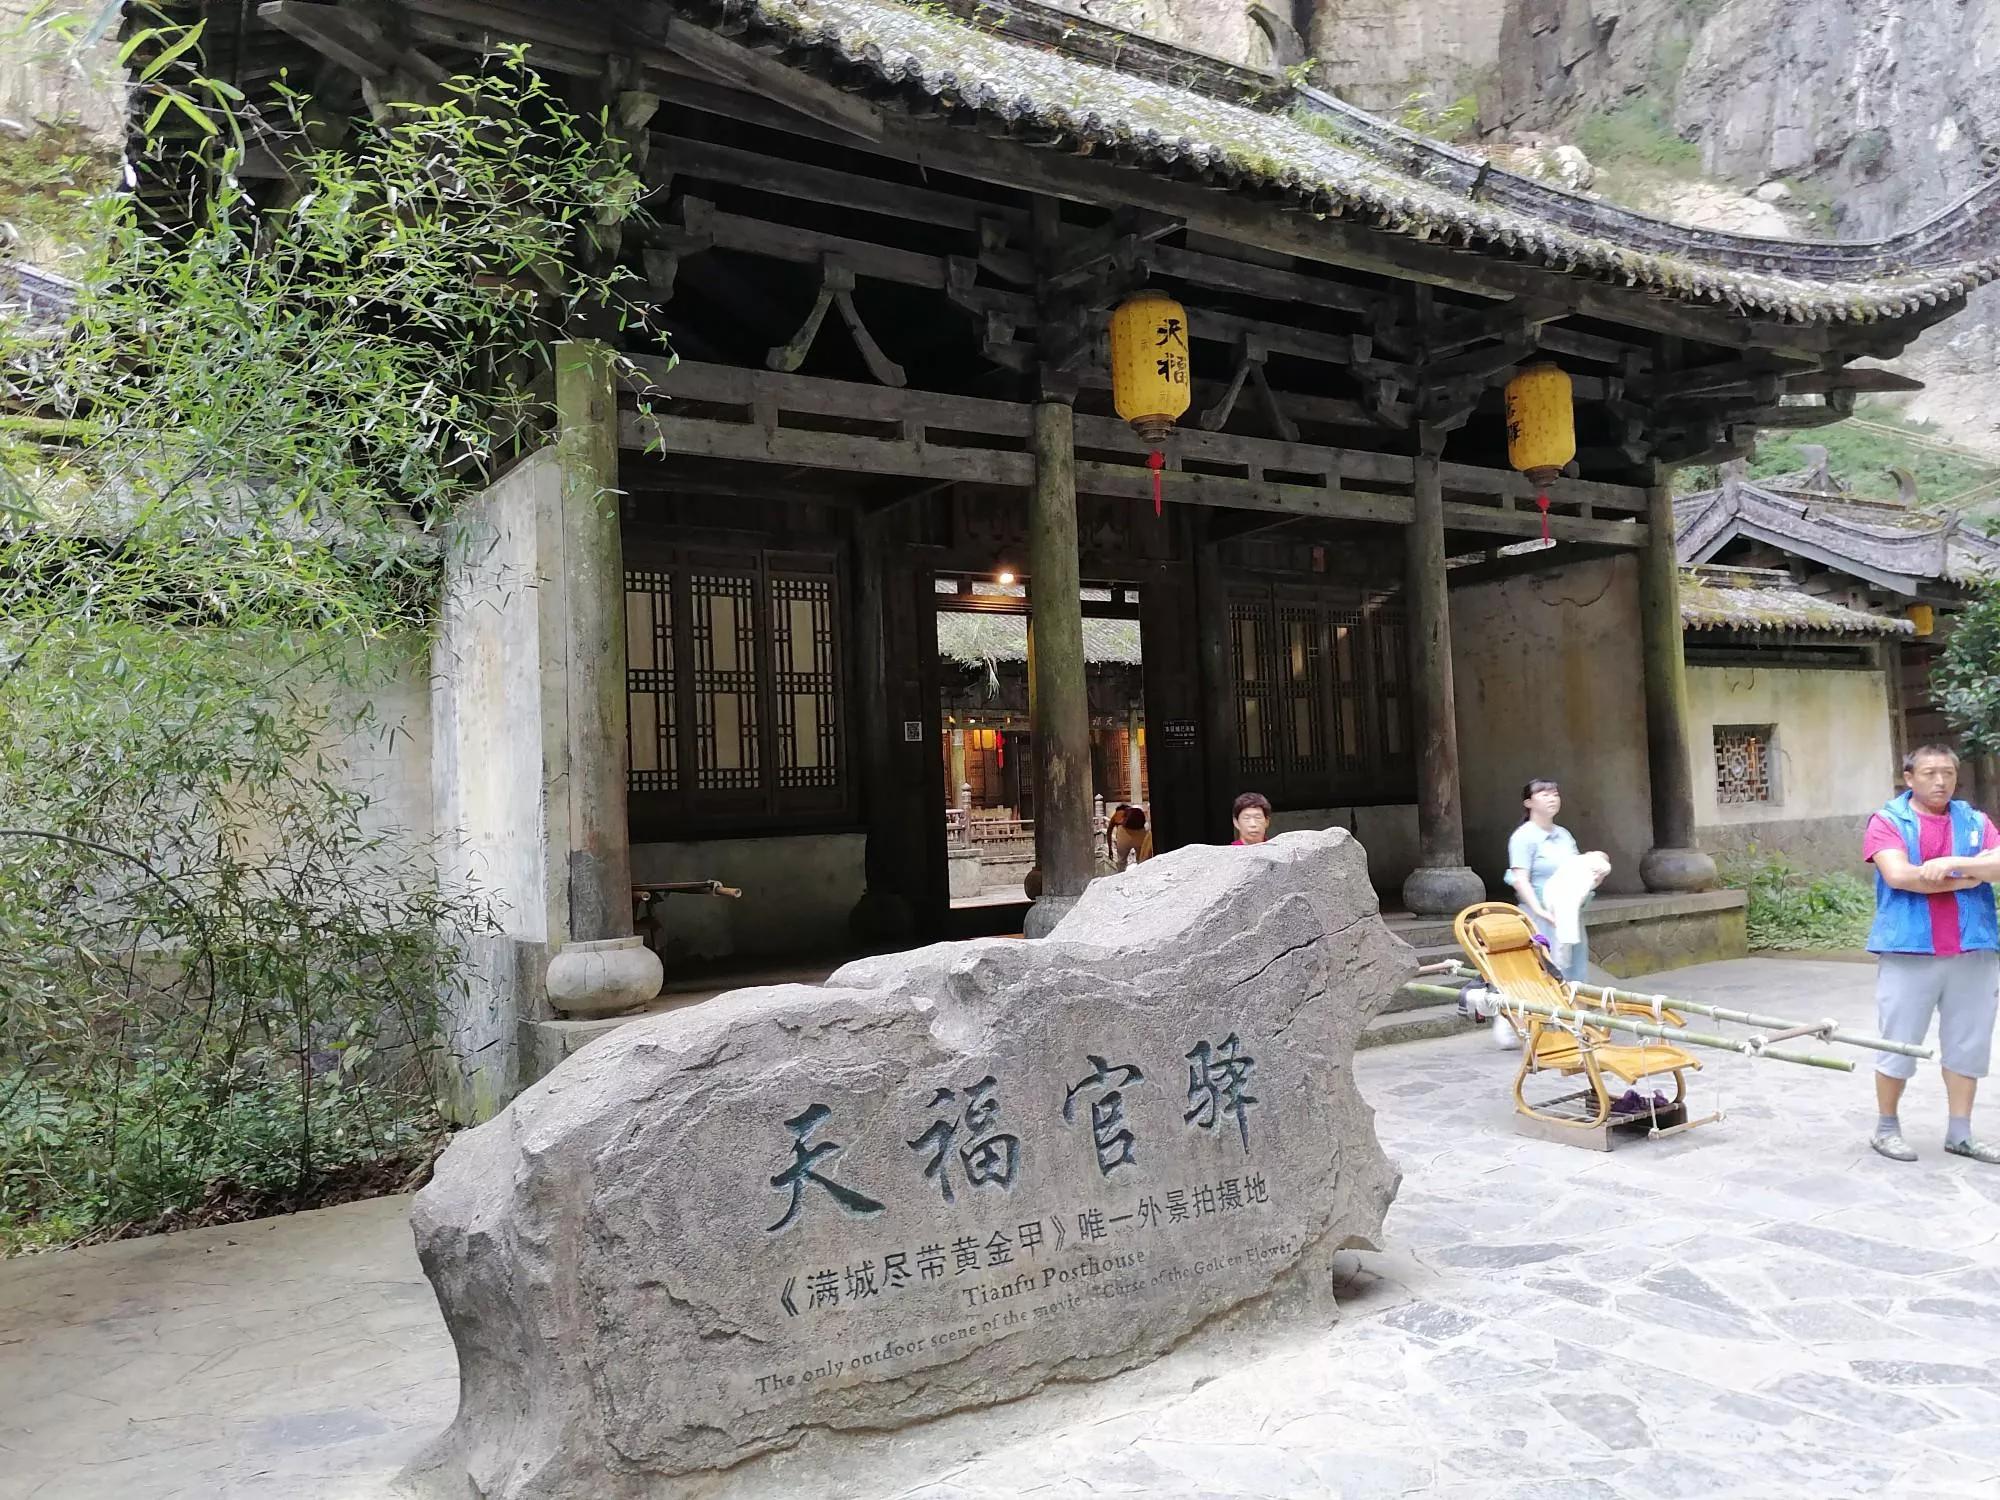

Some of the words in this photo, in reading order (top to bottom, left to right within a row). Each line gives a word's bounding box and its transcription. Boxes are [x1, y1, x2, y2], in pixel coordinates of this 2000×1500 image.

[1155, 318, 1188, 388] 天福
[766, 1032, 1259, 1232] 天福官驿
[755, 1374, 795, 1395] The
[802, 1360, 844, 1383] only
[851, 1340, 925, 1369] outdoor
[930, 1326, 977, 1348] scene
[982, 1313, 1000, 1331] of
[1003, 1309, 1028, 1327] the
[1033, 1294, 1082, 1318] movie
[1151, 1269, 1168, 1287] of
[1168, 1265, 1189, 1283] the
[1194, 1255, 1242, 1275] Golden
[963, 1274, 1036, 1307] Tianfu
[1042, 1251, 1145, 1288] Posthouse
